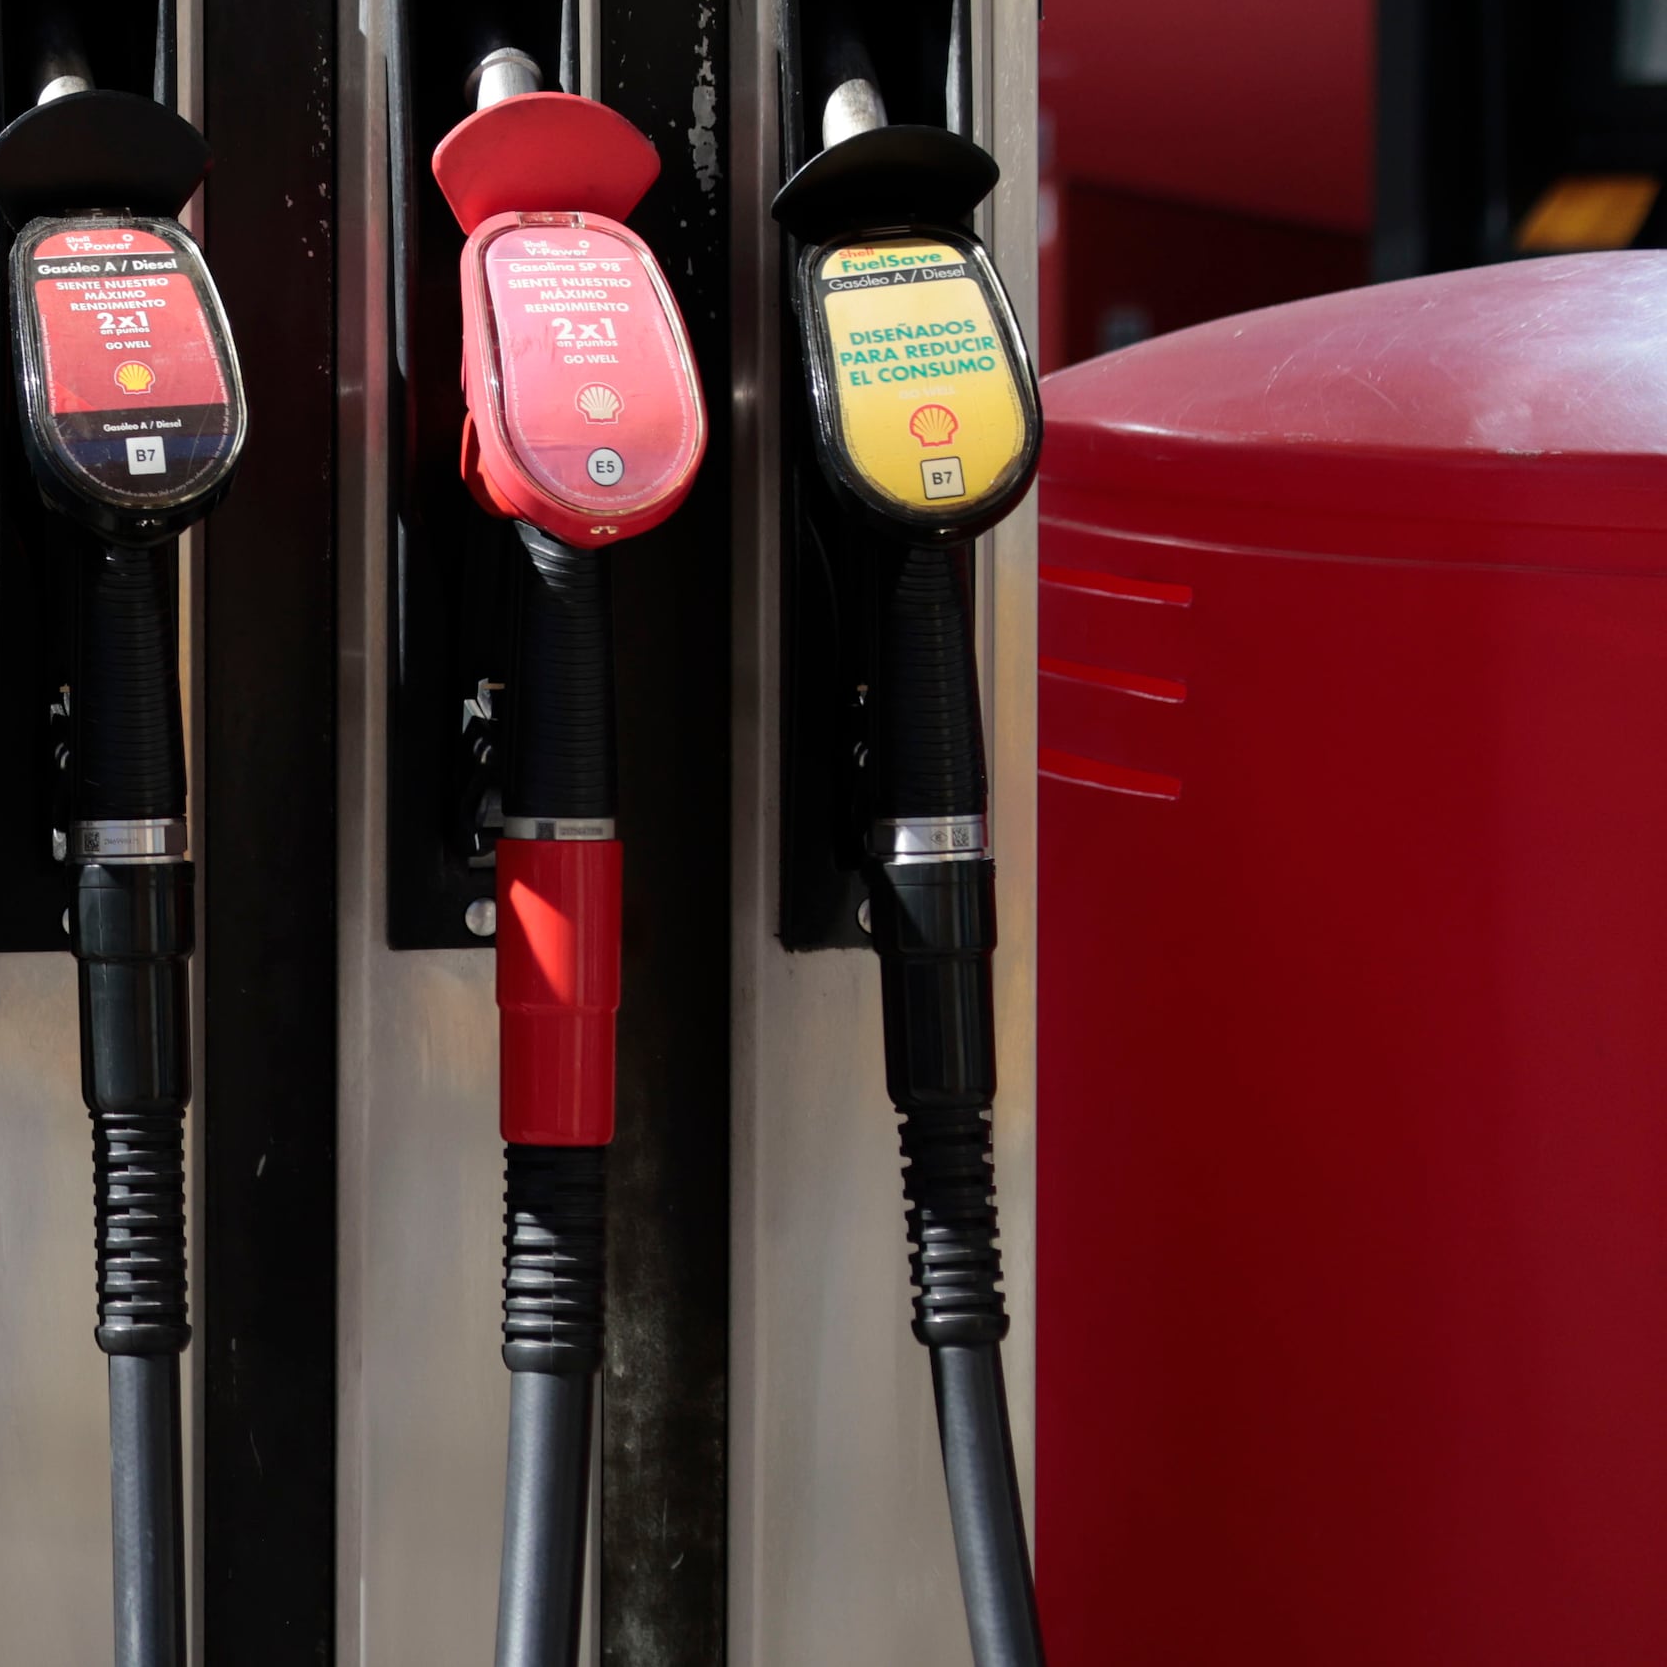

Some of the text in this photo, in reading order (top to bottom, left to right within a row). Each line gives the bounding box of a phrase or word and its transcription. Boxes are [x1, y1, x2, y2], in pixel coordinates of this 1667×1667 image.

[65, 235, 90, 243] Shell
[67, 242, 132, 252] V-Power
[525, 247, 588, 256] V-Power
[838, 246, 875, 259] Shell
[37, 258, 178, 275] Gasóleo A Diesel
[508, 261, 621, 273] Gasolina SP 98
[841, 252, 942, 273] FuelSave
[55, 277, 169, 291] SIENTE NUESTRO
[508, 277, 632, 288] SIENTE NUESTRO
[828, 265, 966, 291] Gasóleo A Diesel
[84, 290, 146, 301] MÁXIMO
[540, 287, 608, 300] MÁXIMO
[70, 299, 167, 312] RENDIMIENTO
[524, 302, 630, 313] RENDIMIENTO
[96, 311, 149, 329] 2x1
[116, 327, 150, 336] puntos
[551, 317, 617, 340] 2x1
[849, 319, 977, 346] DISEÑADOS
[105, 340, 152, 350] GO WELL
[556, 339, 619, 349] en puntos
[839, 336, 997, 367] PARA REDUCIR
[563, 354, 620, 364] GO WELL
[849, 355, 996, 386] EL CONSUMO
[103, 418, 182, 432] Gasóleo A Diesel
[136, 448, 156, 462] B7
[595, 460, 616, 474] E5
[932, 471, 953, 485] B7
